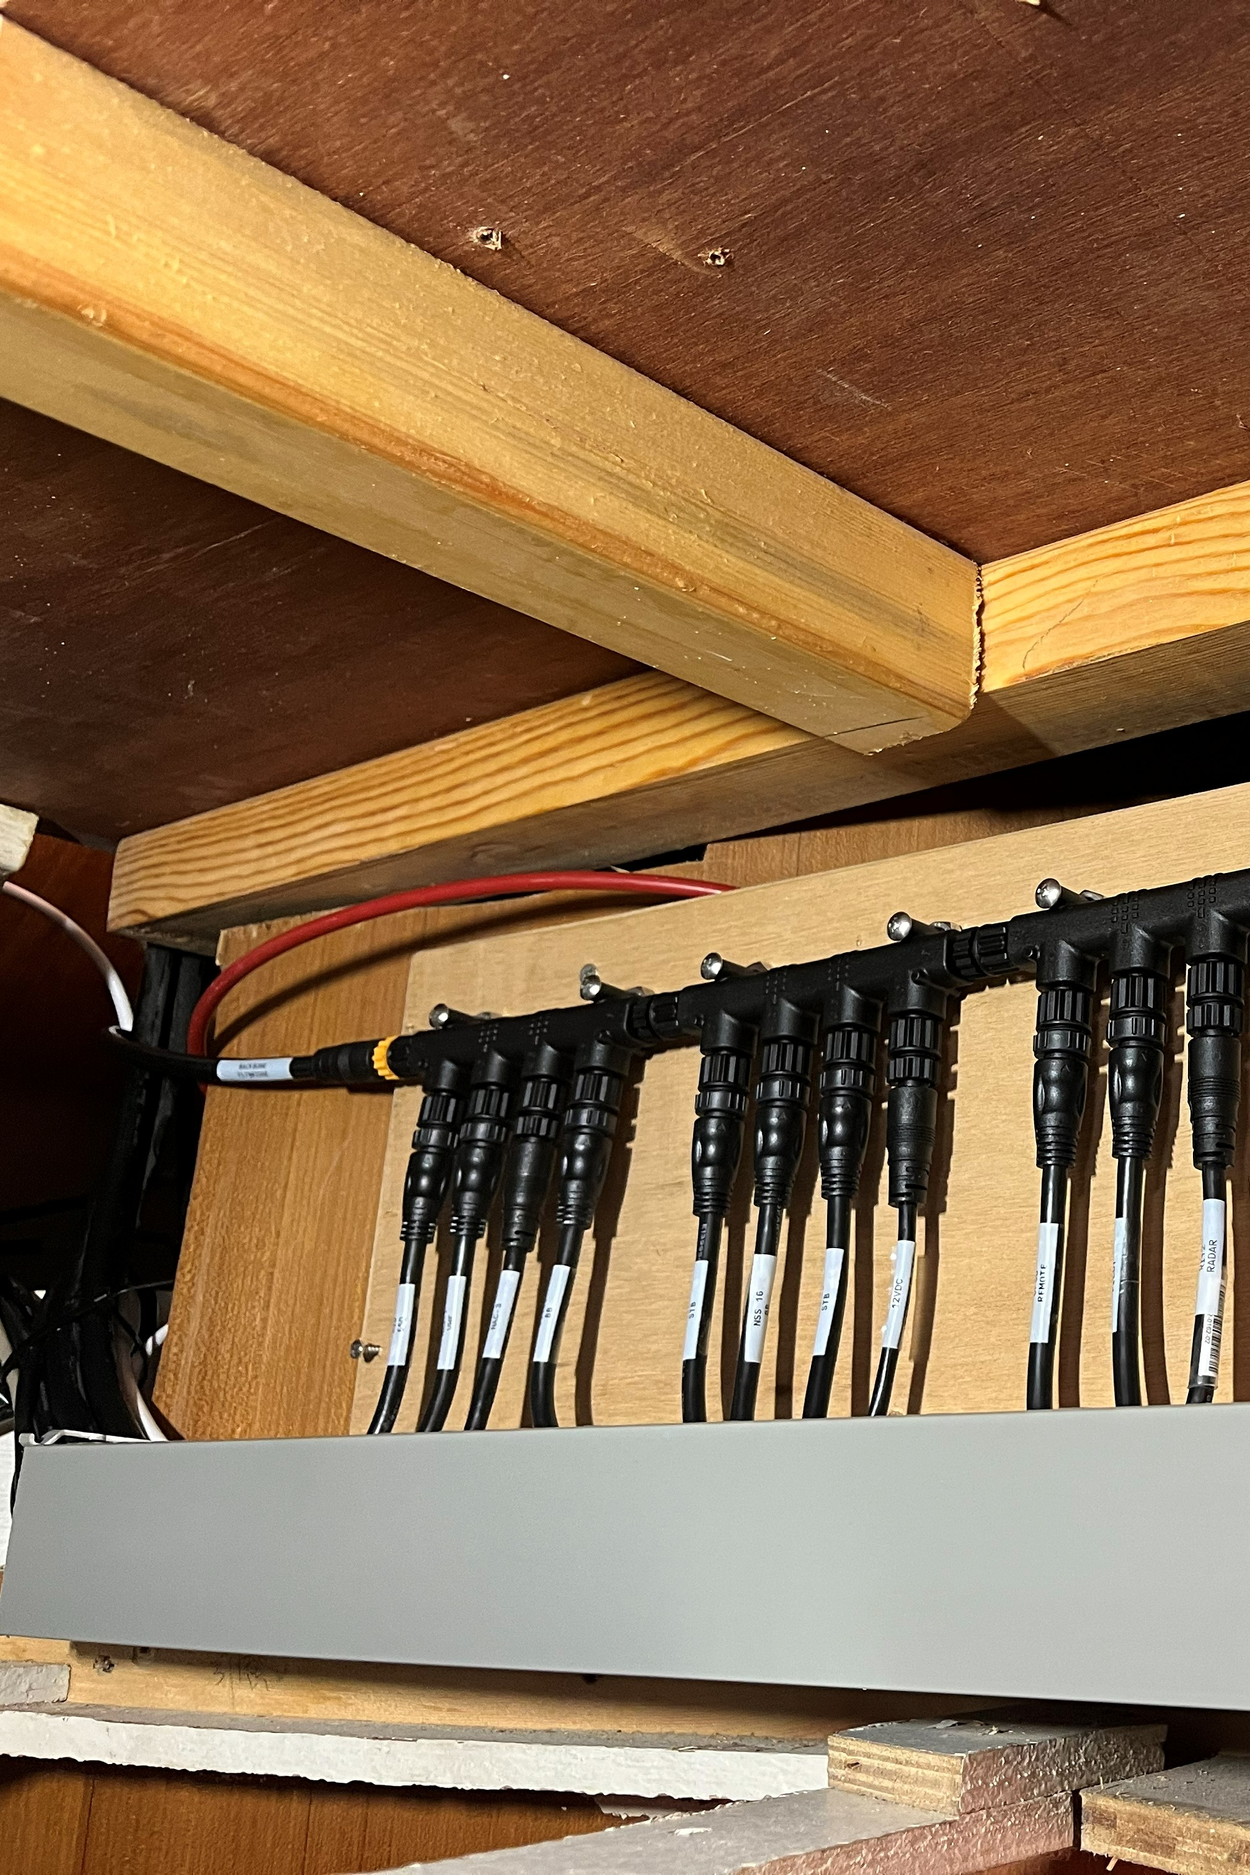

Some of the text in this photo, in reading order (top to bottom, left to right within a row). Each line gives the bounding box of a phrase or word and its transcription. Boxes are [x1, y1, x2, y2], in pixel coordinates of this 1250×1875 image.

[1207, 1239, 1218, 1273] RADAR
[891, 1278, 904, 1309] 12VDC
[1037, 1263, 1048, 1303] REMOTE
[753, 1290, 764, 1327] NSS 16
[821, 1292, 831, 1312] STB
